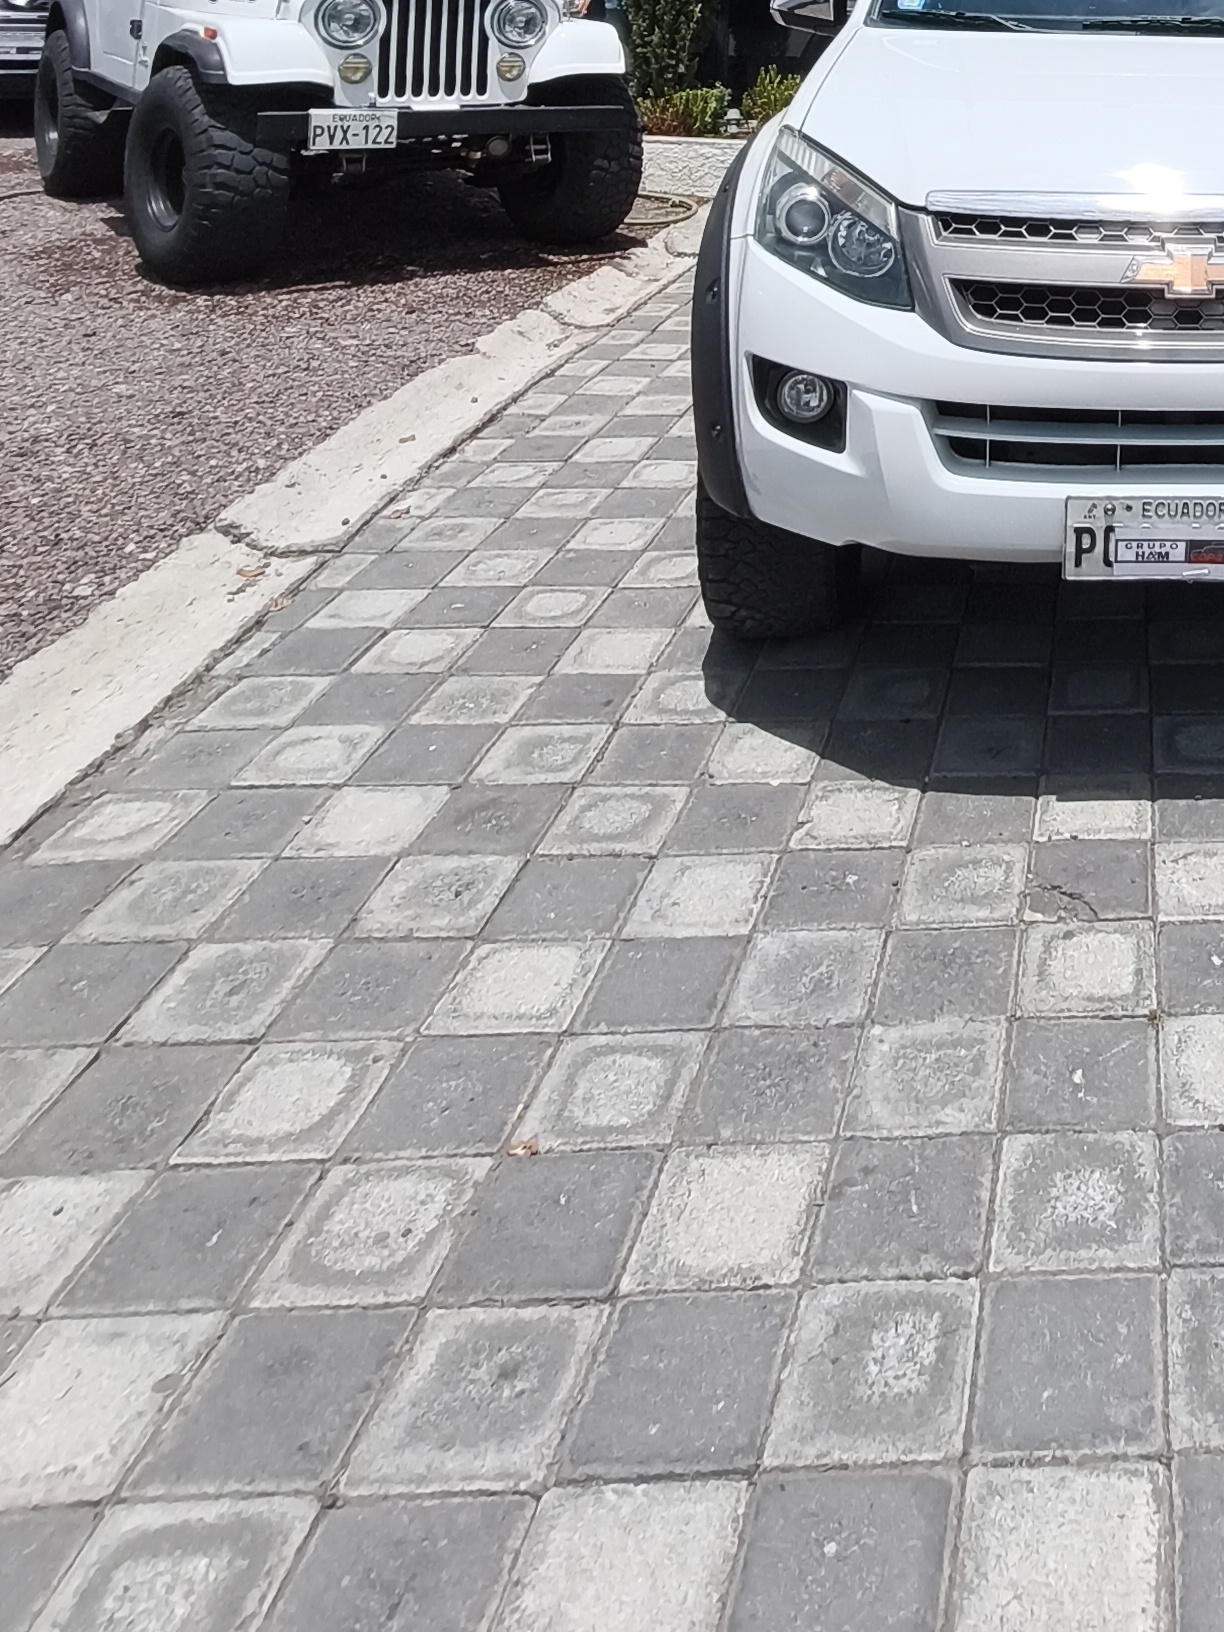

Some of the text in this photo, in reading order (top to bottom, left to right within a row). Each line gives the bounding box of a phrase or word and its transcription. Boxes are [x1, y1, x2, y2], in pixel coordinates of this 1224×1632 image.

[332, 114, 380, 123] ECUADOR
[312, 125, 395, 146] PVX-122
[1125, 542, 1179, 550] GRUPO
